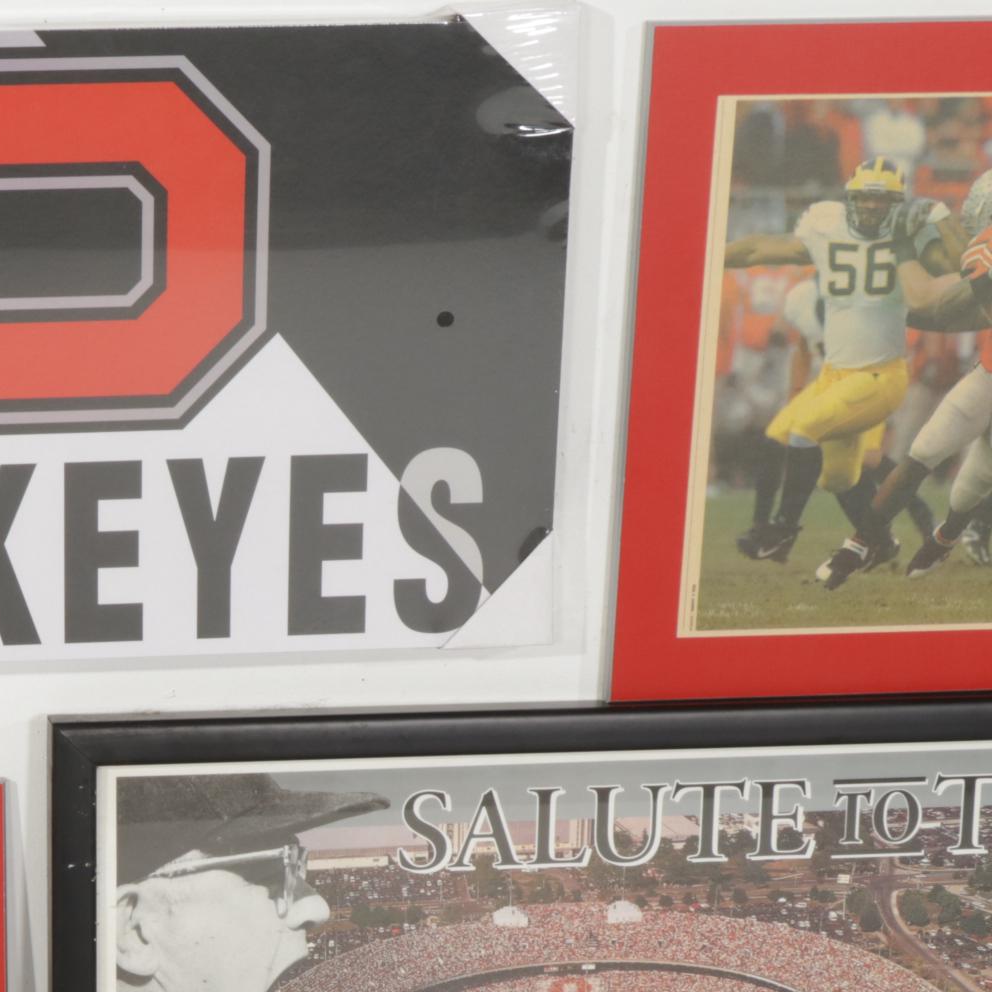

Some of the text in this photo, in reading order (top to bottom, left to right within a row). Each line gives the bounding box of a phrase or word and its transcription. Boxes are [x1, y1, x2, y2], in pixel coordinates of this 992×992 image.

[828, 241, 897, 296] 56
[397, 778, 816, 874] SALUTE
[833, 788, 922, 846] TO
